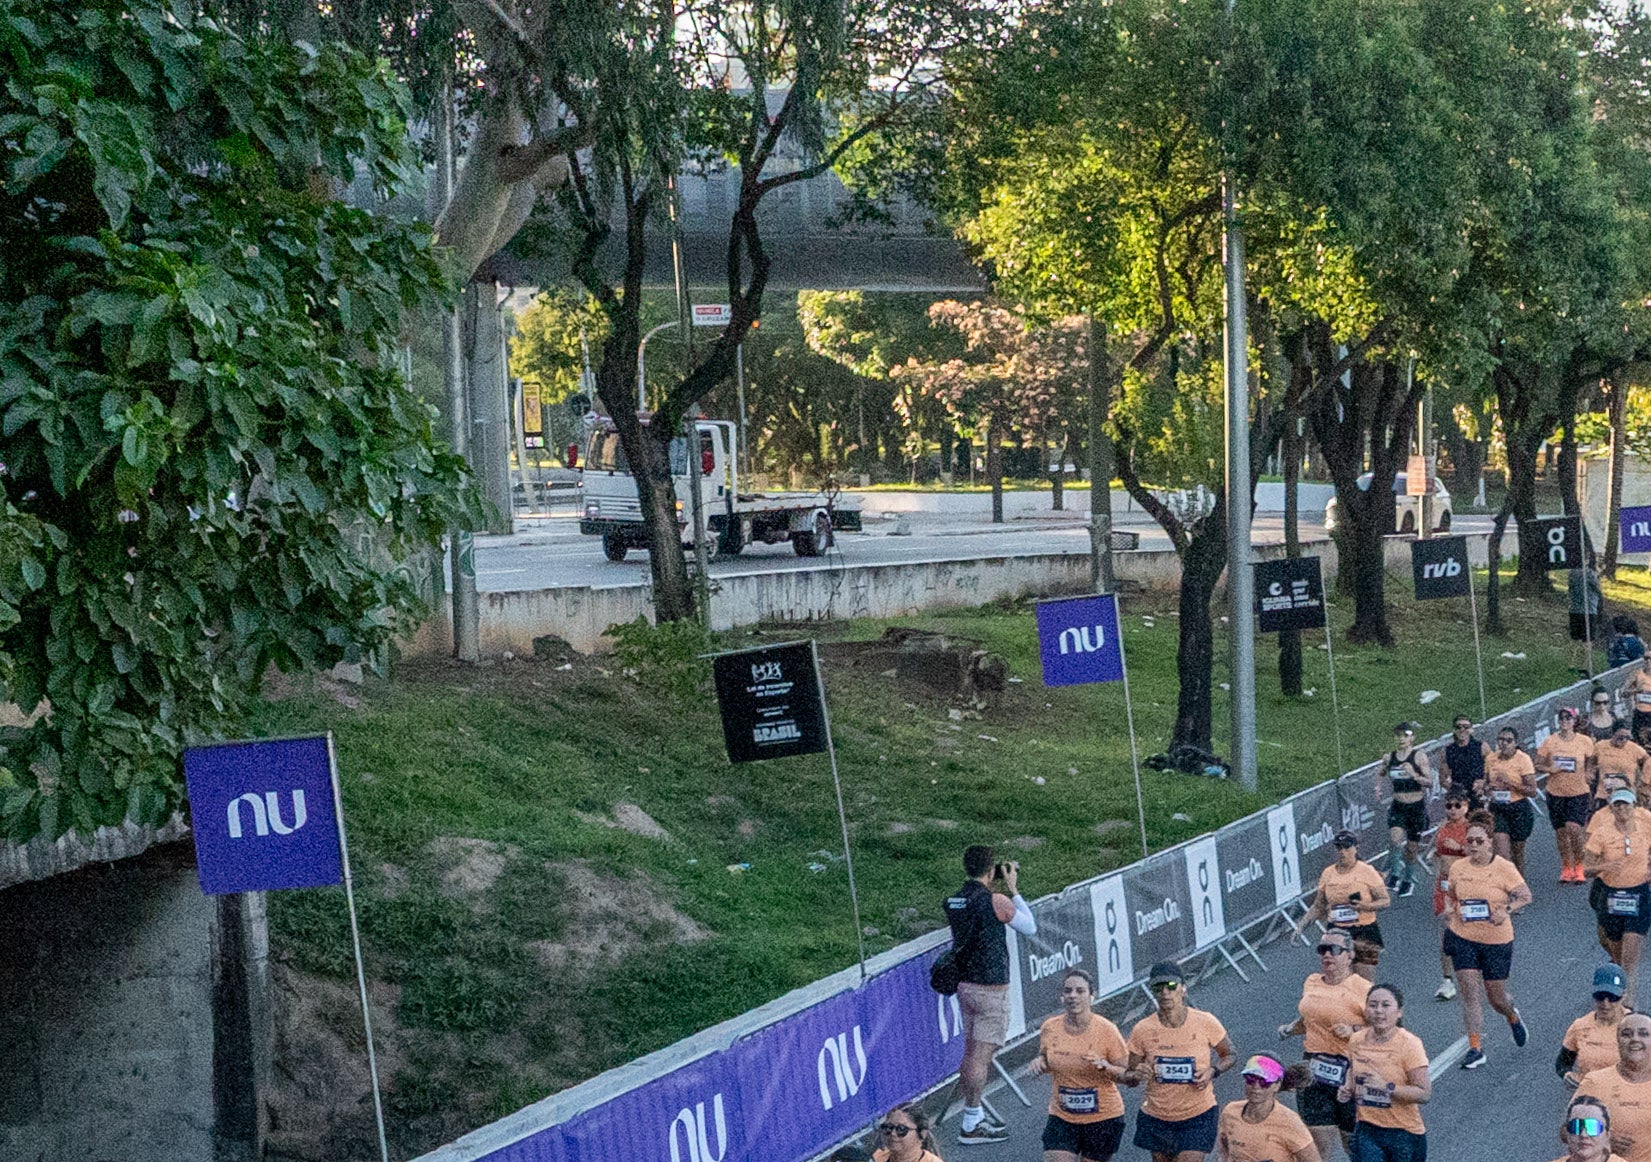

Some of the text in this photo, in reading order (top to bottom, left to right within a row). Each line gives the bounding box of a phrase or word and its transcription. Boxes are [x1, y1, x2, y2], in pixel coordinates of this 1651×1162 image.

[1423, 557, 1461, 579] rvb
[1058, 626, 1105, 655] nu
[226, 788, 308, 840] nu
[1135, 906, 1165, 936] Dream
[1029, 948, 1064, 982] Dream
[818, 1024, 868, 1111] nu
[1165, 1064, 1190, 1076] 2543
